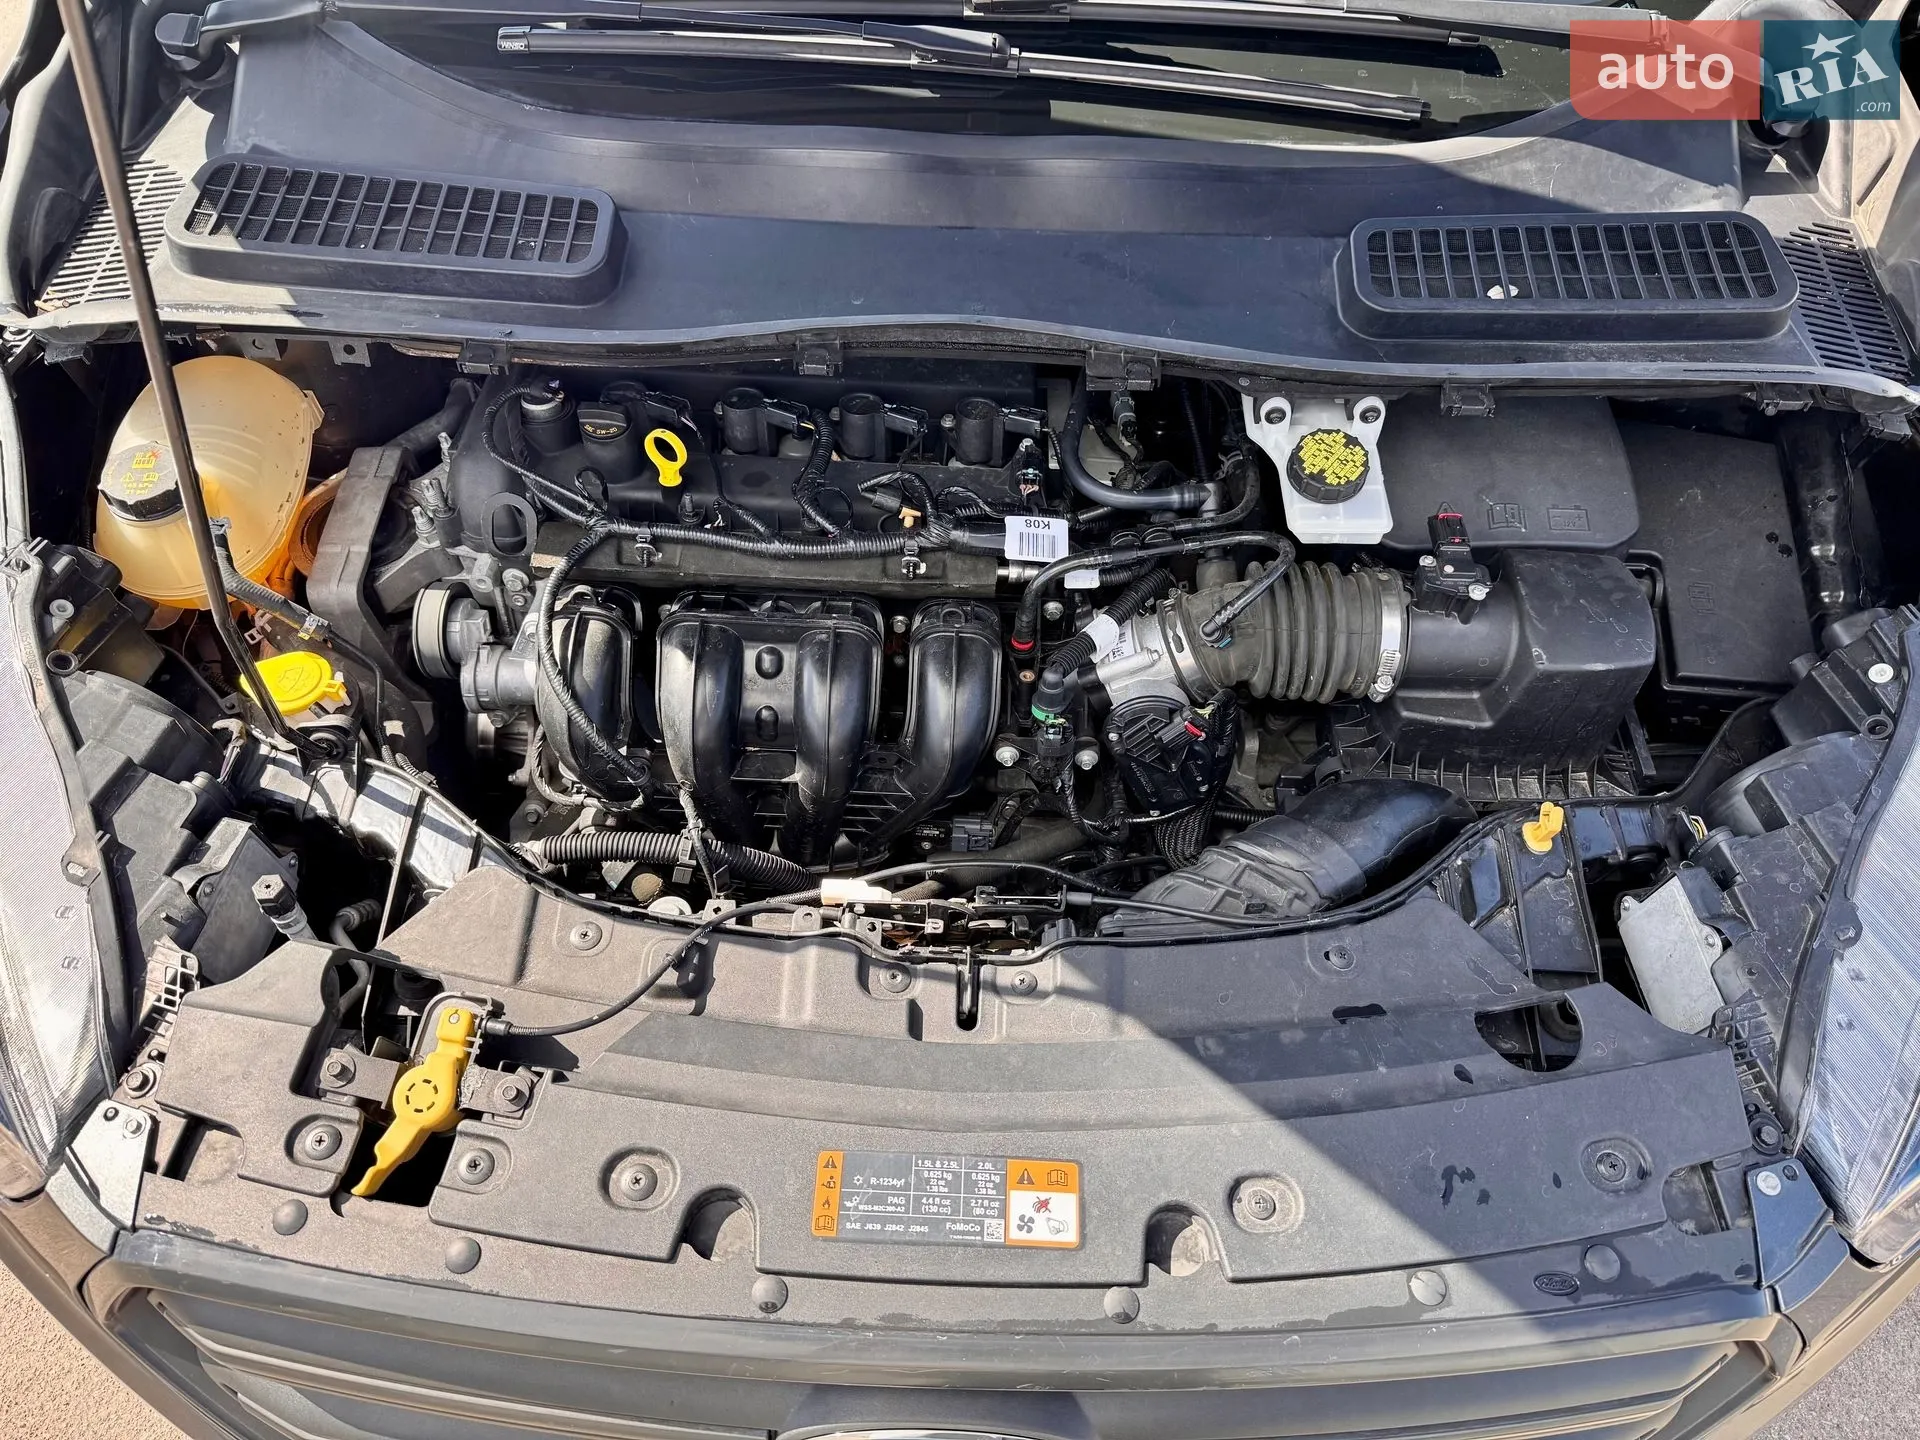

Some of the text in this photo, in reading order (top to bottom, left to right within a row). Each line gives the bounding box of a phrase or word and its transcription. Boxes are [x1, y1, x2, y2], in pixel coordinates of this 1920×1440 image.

[1025, 519, 1050, 530] K08
[918, 1160, 934, 1168] 1.5L
[943, 1161, 960, 1169] 2.5L
[978, 1162, 995, 1170] 2.0L
[924, 1171, 952, 1180] 0.625 kg
[971, 1173, 1000, 1183] 0.625 kg
[870, 1177, 905, 1188] R-1234yf
[887, 1196, 905, 1205] PAG
[934, 1197, 940, 1205] fl
[970, 1199, 982, 1207] 2.7
[921, 1205, 951, 1215] (130 cc)
[986, 1208, 998, 1217] cc)
[846, 1222, 861, 1230] SAE
[946, 1222, 980, 1232] FoMoCo
